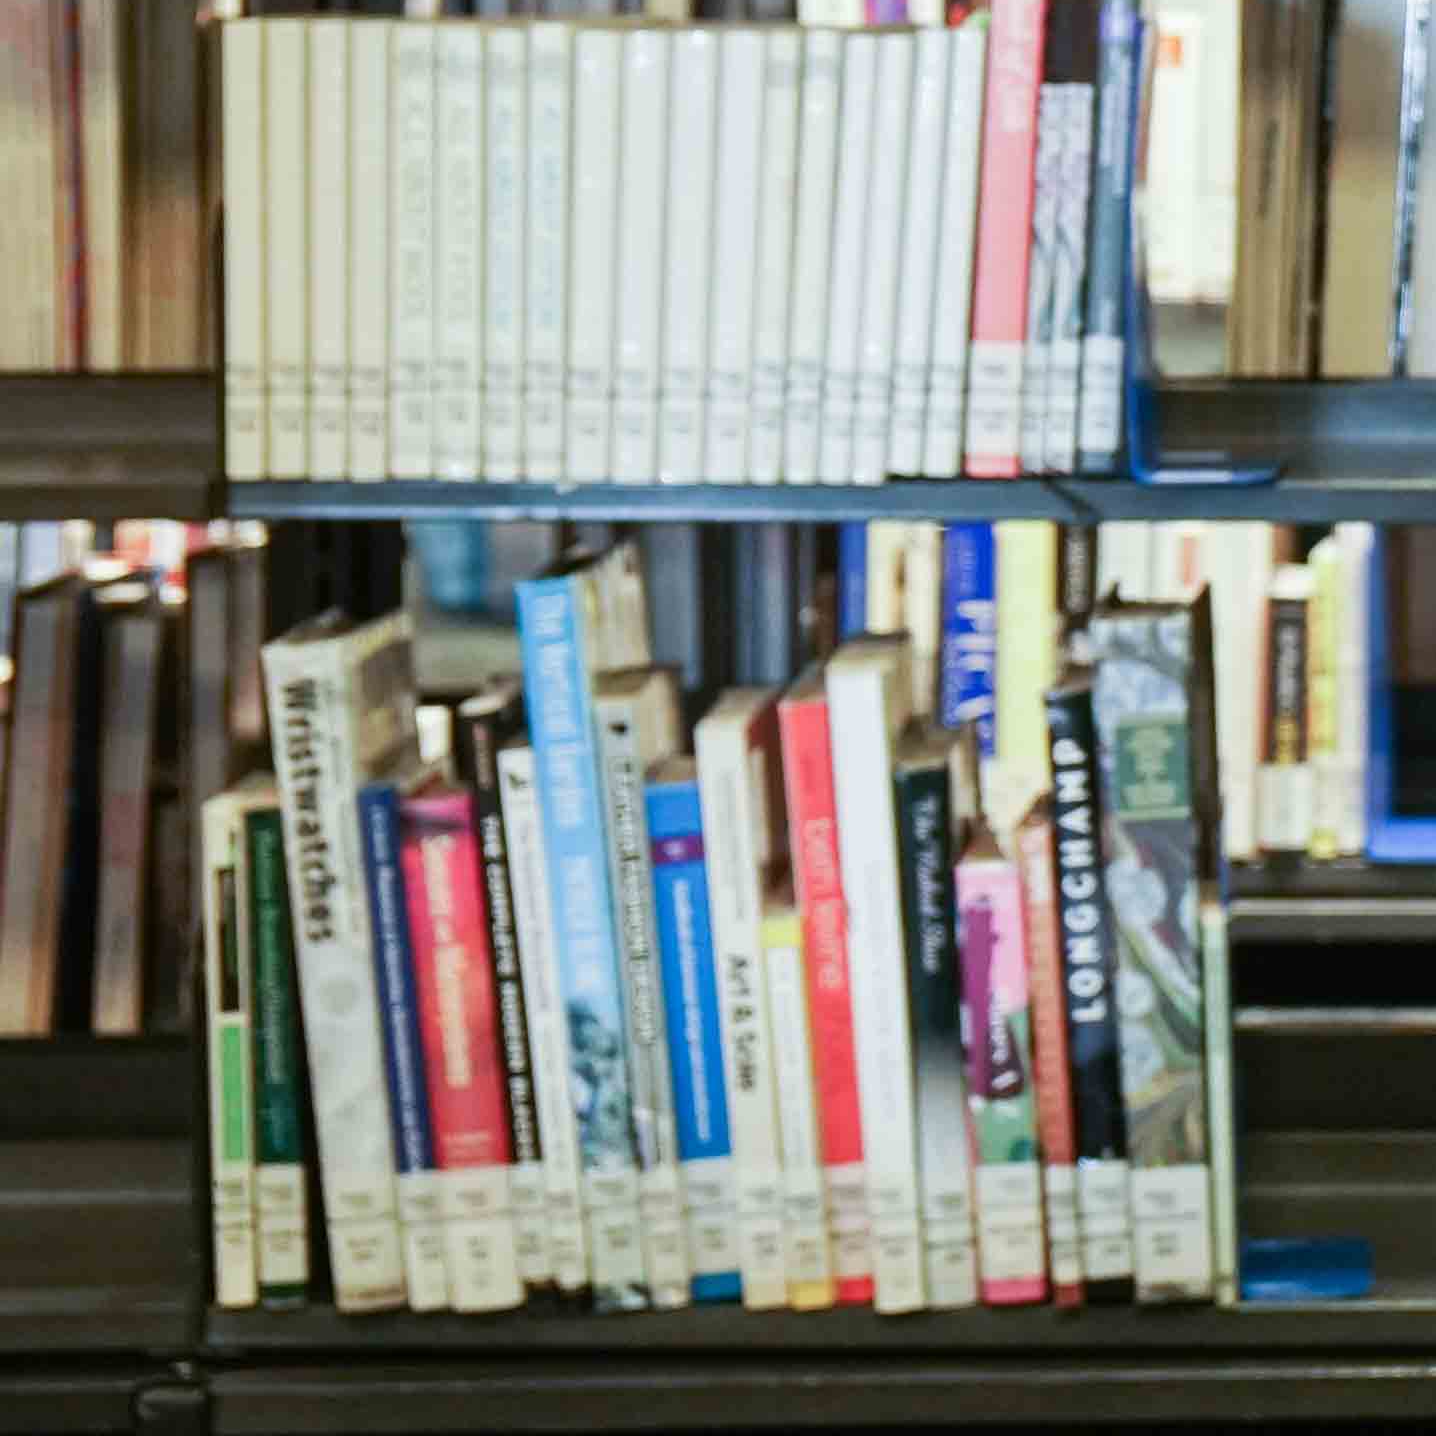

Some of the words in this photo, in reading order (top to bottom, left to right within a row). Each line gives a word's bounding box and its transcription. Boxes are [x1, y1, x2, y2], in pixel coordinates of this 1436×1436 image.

[276, 677, 334, 948] Wristwatches
[1052, 736, 1107, 1024] LONGCHAMP
[727, 953, 755, 996] Art
